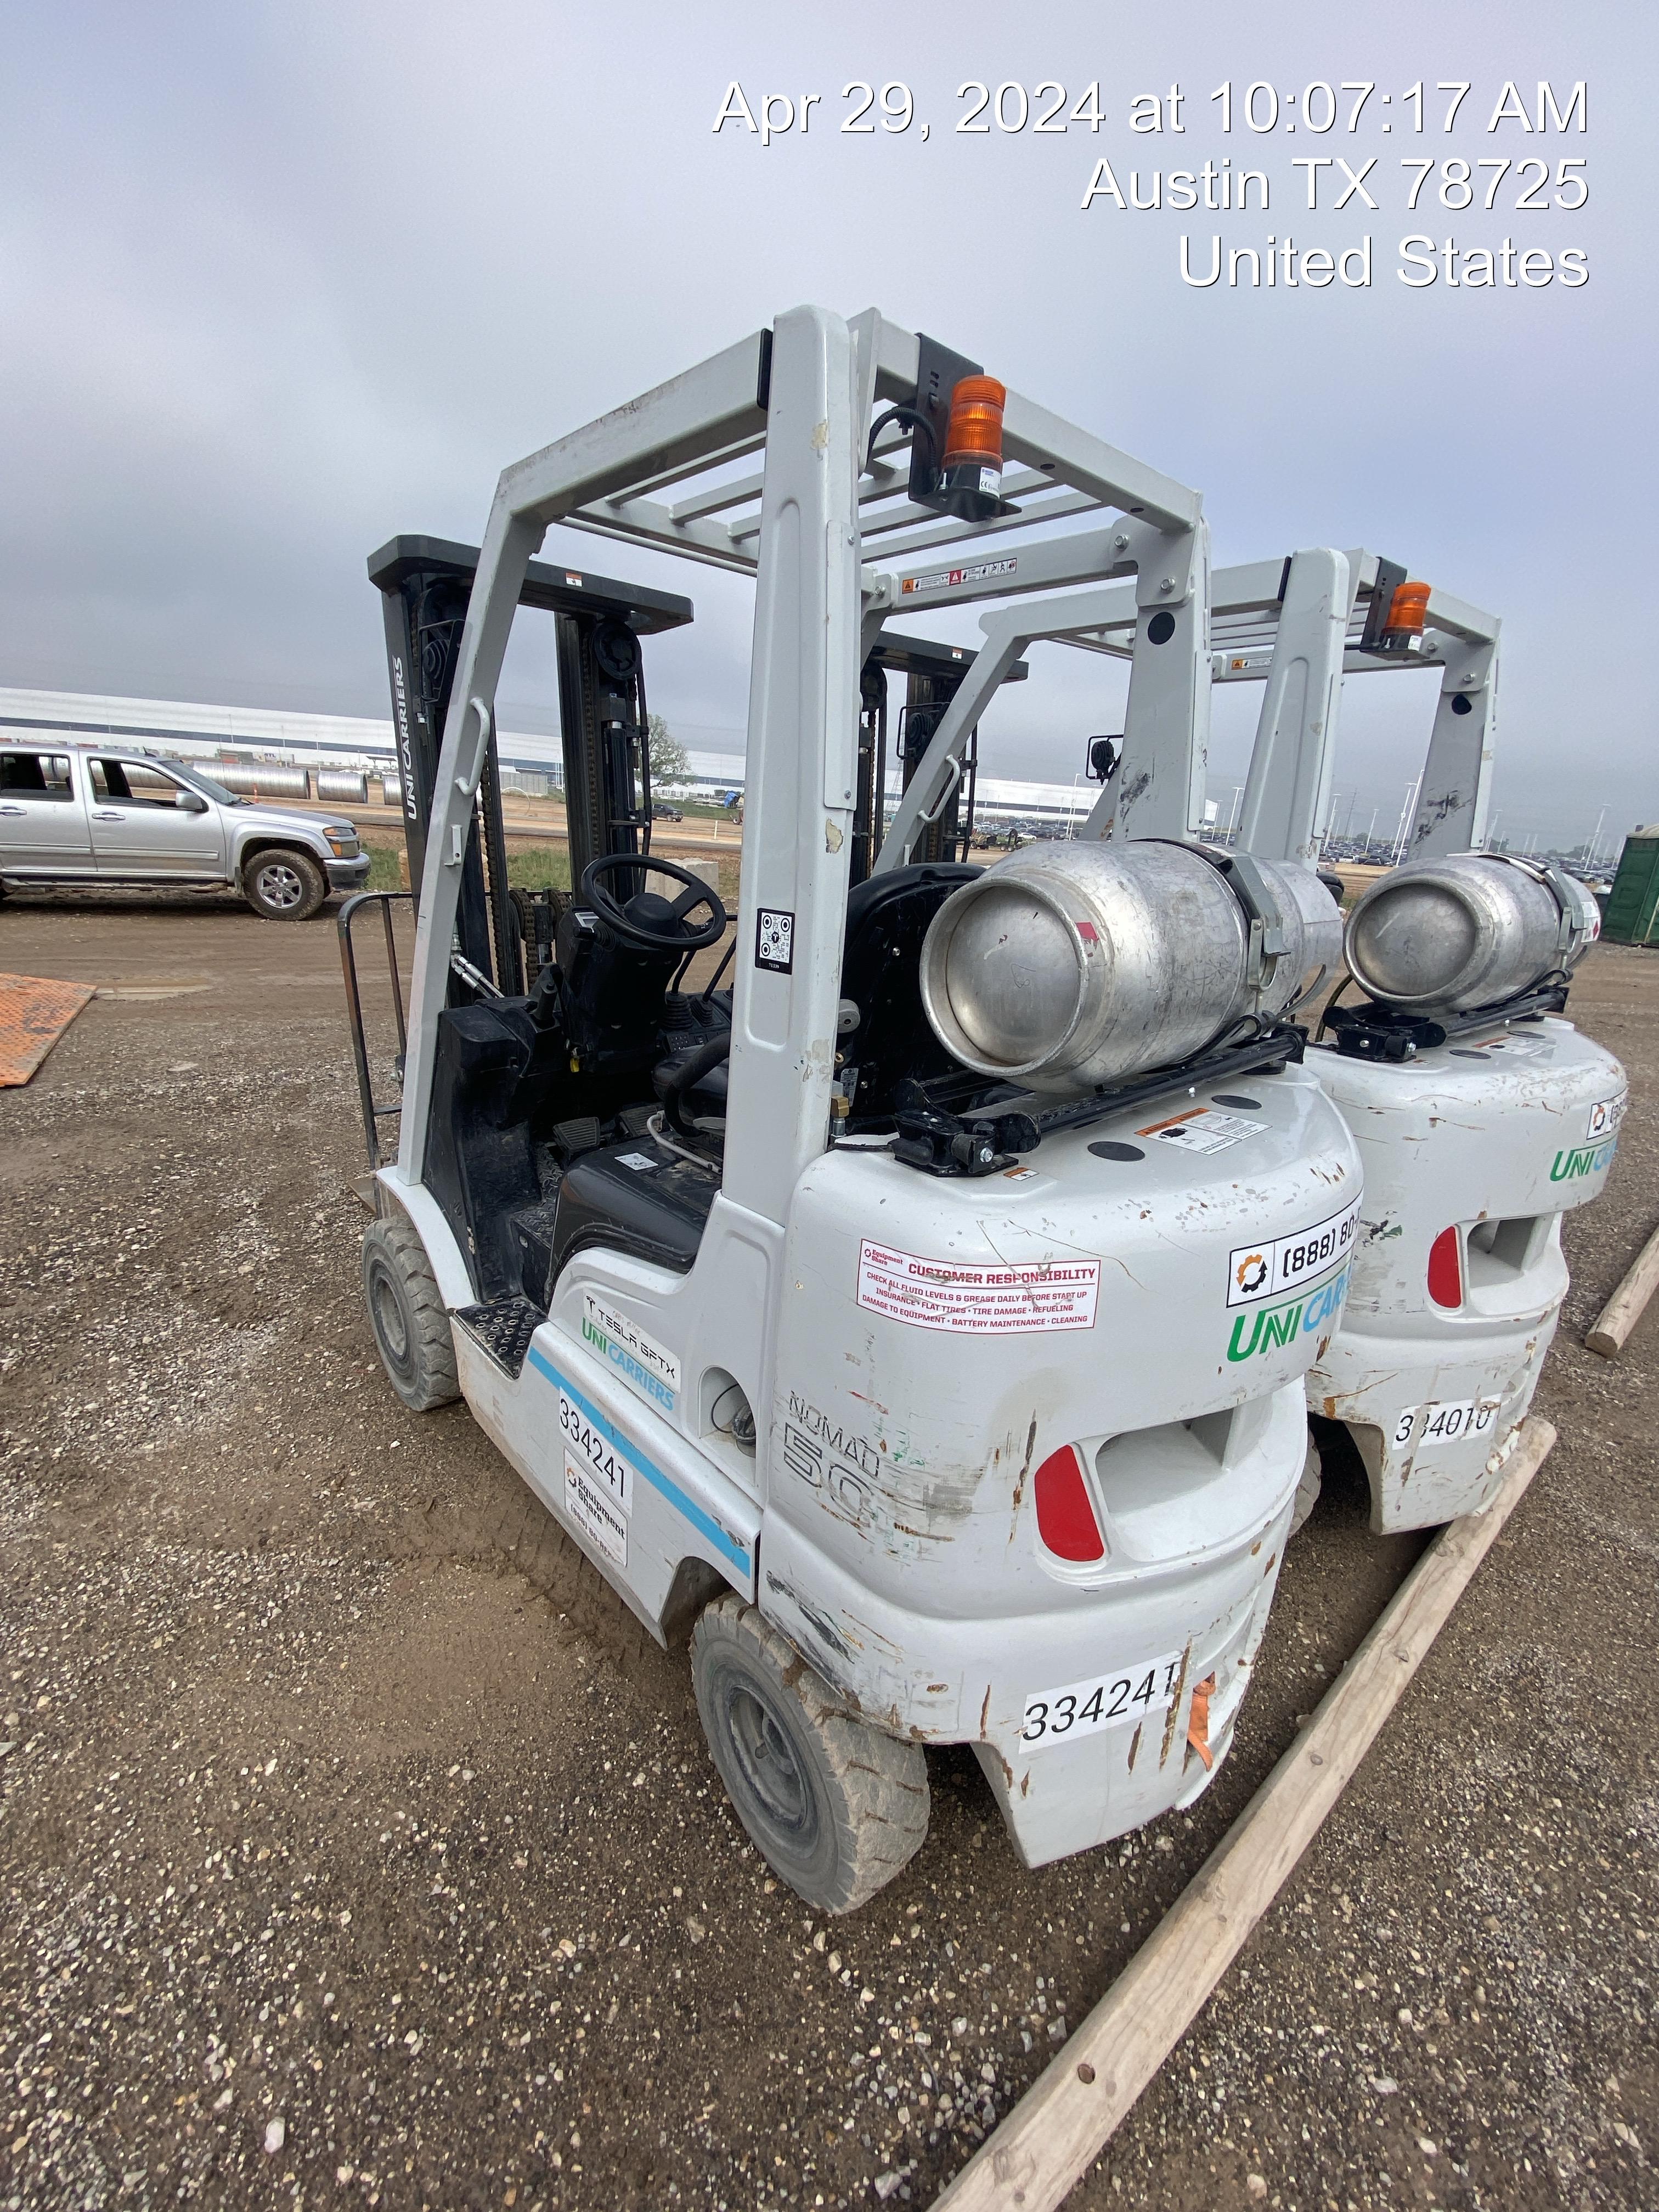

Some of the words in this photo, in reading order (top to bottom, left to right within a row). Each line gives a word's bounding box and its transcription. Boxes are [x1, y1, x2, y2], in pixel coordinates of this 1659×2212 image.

[392, 656, 417, 821] UNICARRIERS
[871, 1256, 888, 1266] Share
[872, 1249, 904, 1265] Equipment
[909, 1263, 983, 1284] CUSTOMER
[986, 1268, 1096, 1284] RESPONSIBILITY
[1283, 1228, 1335, 1278] (888)
[867, 1272, 887, 1284] CHECK
[888, 1280, 900, 1290] ALL
[901, 1284, 923, 1295] FLUID
[925, 1290, 954, 1301] LEVELS
[1052, 1292, 1075, 1300] START
[876, 1288, 916, 1306] INSURANCE
[922, 1301, 940, 1311] FLAT
[941, 1305, 966, 1313] TIRES
[1032, 1304, 1074, 1313] REFUELING
[862, 1295, 888, 1310] DAMAGE
[889, 1305, 898, 1313] TO
[900, 1308, 945, 1323] EQUIPMENT
[952, 1318, 988, 1327] BATTERY
[990, 1318, 1046, 1327] MAINTENANCE
[1051, 1316, 1088, 1324] CLEANING
[582, 1317, 674, 1410] UNICARRIERS
[598, 1309, 637, 1348] TESLA
[641, 1342, 675, 1379] GFTX
[560, 1398, 625, 1498] 334241
[789, 1390, 879, 1480] NOMAD
[578, 1488, 602, 1524] Share
[578, 1476, 625, 1540] Equipment
